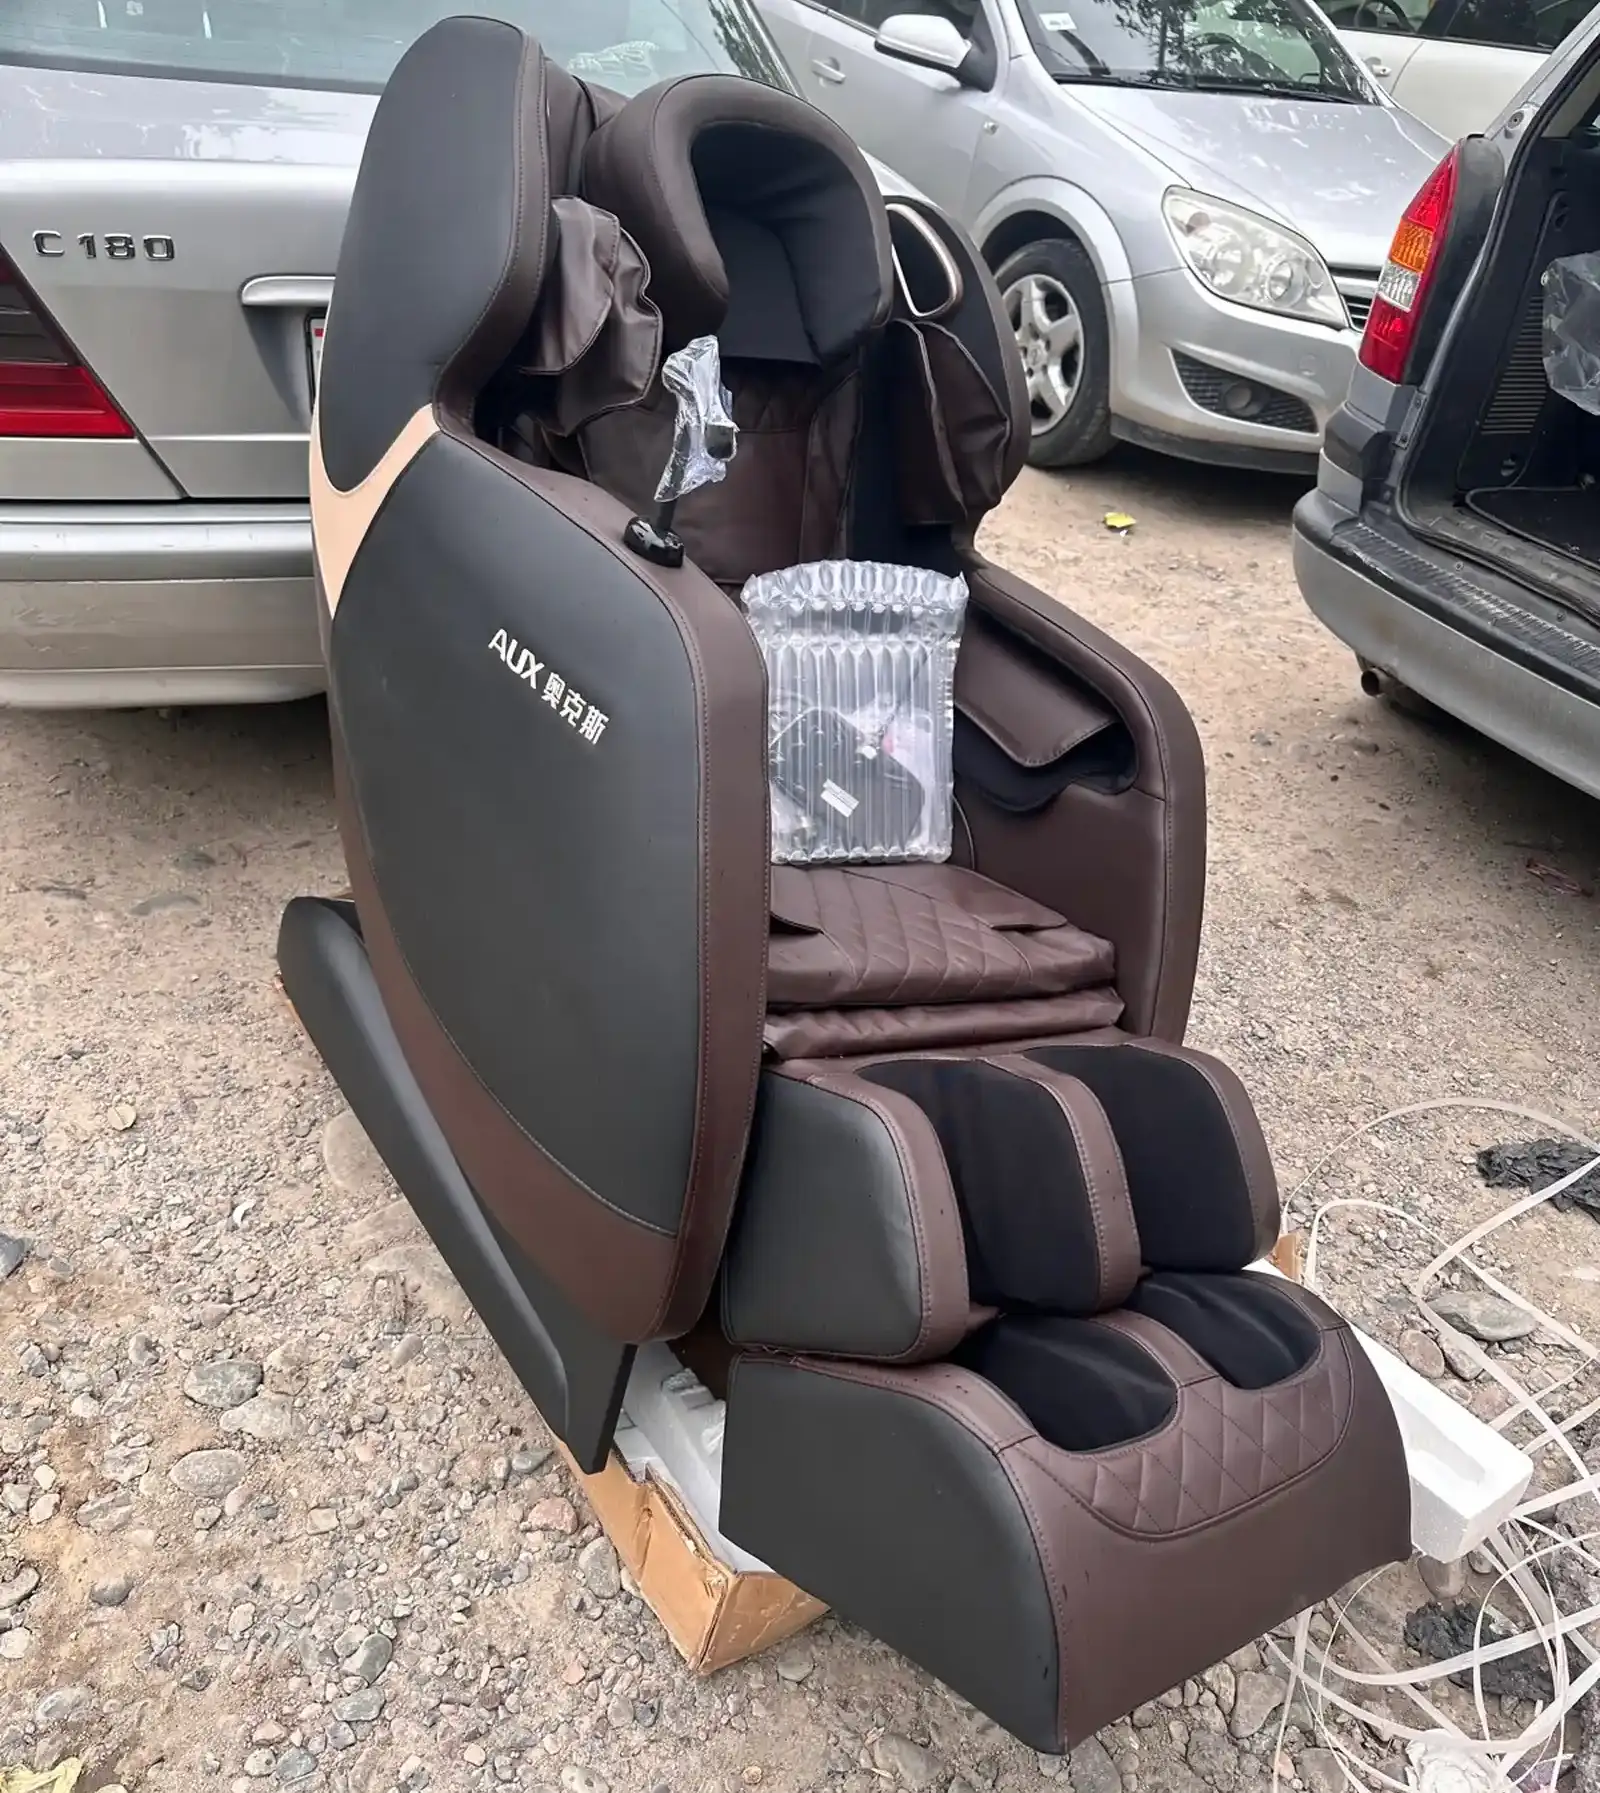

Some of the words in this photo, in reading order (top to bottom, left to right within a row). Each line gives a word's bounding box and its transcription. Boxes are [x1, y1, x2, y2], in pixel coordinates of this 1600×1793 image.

[32, 230, 65, 257] C
[77, 232, 175, 261] 180
[488, 628, 545, 689] AUX
[541, 672, 609, 745] 奥克斯
